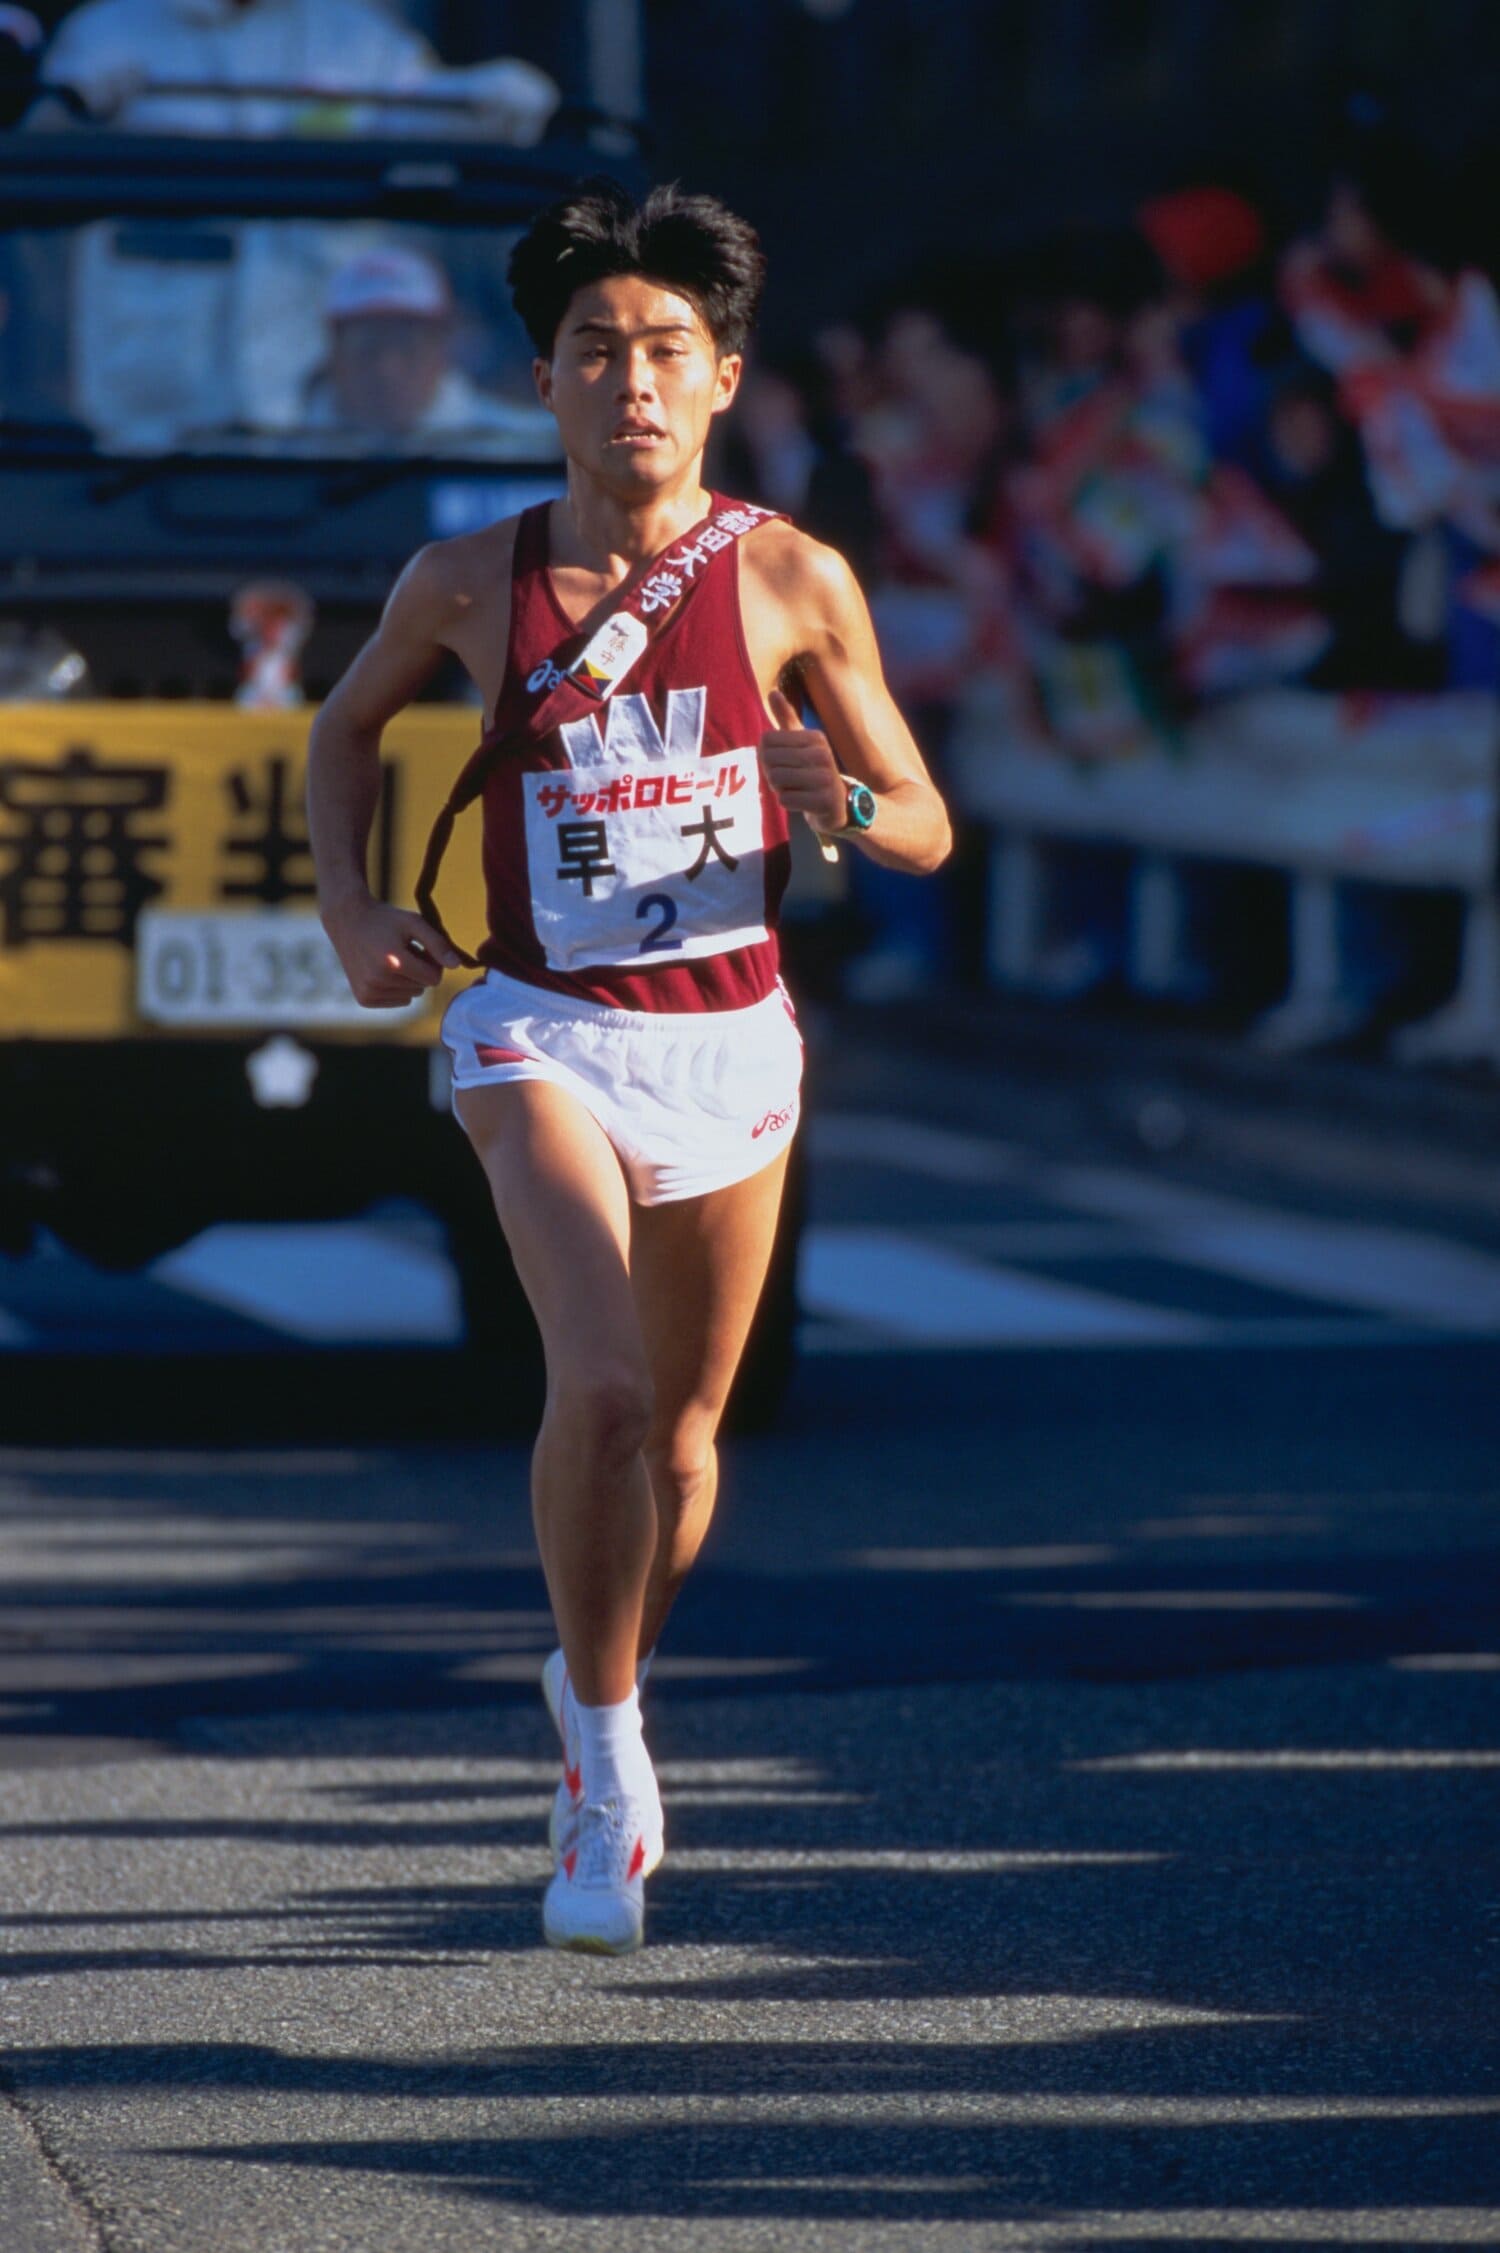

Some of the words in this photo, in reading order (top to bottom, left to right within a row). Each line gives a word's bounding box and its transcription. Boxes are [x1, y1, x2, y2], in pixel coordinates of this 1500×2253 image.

[536, 765, 747, 819] サッポロビール
[636, 893, 684, 953] 2
